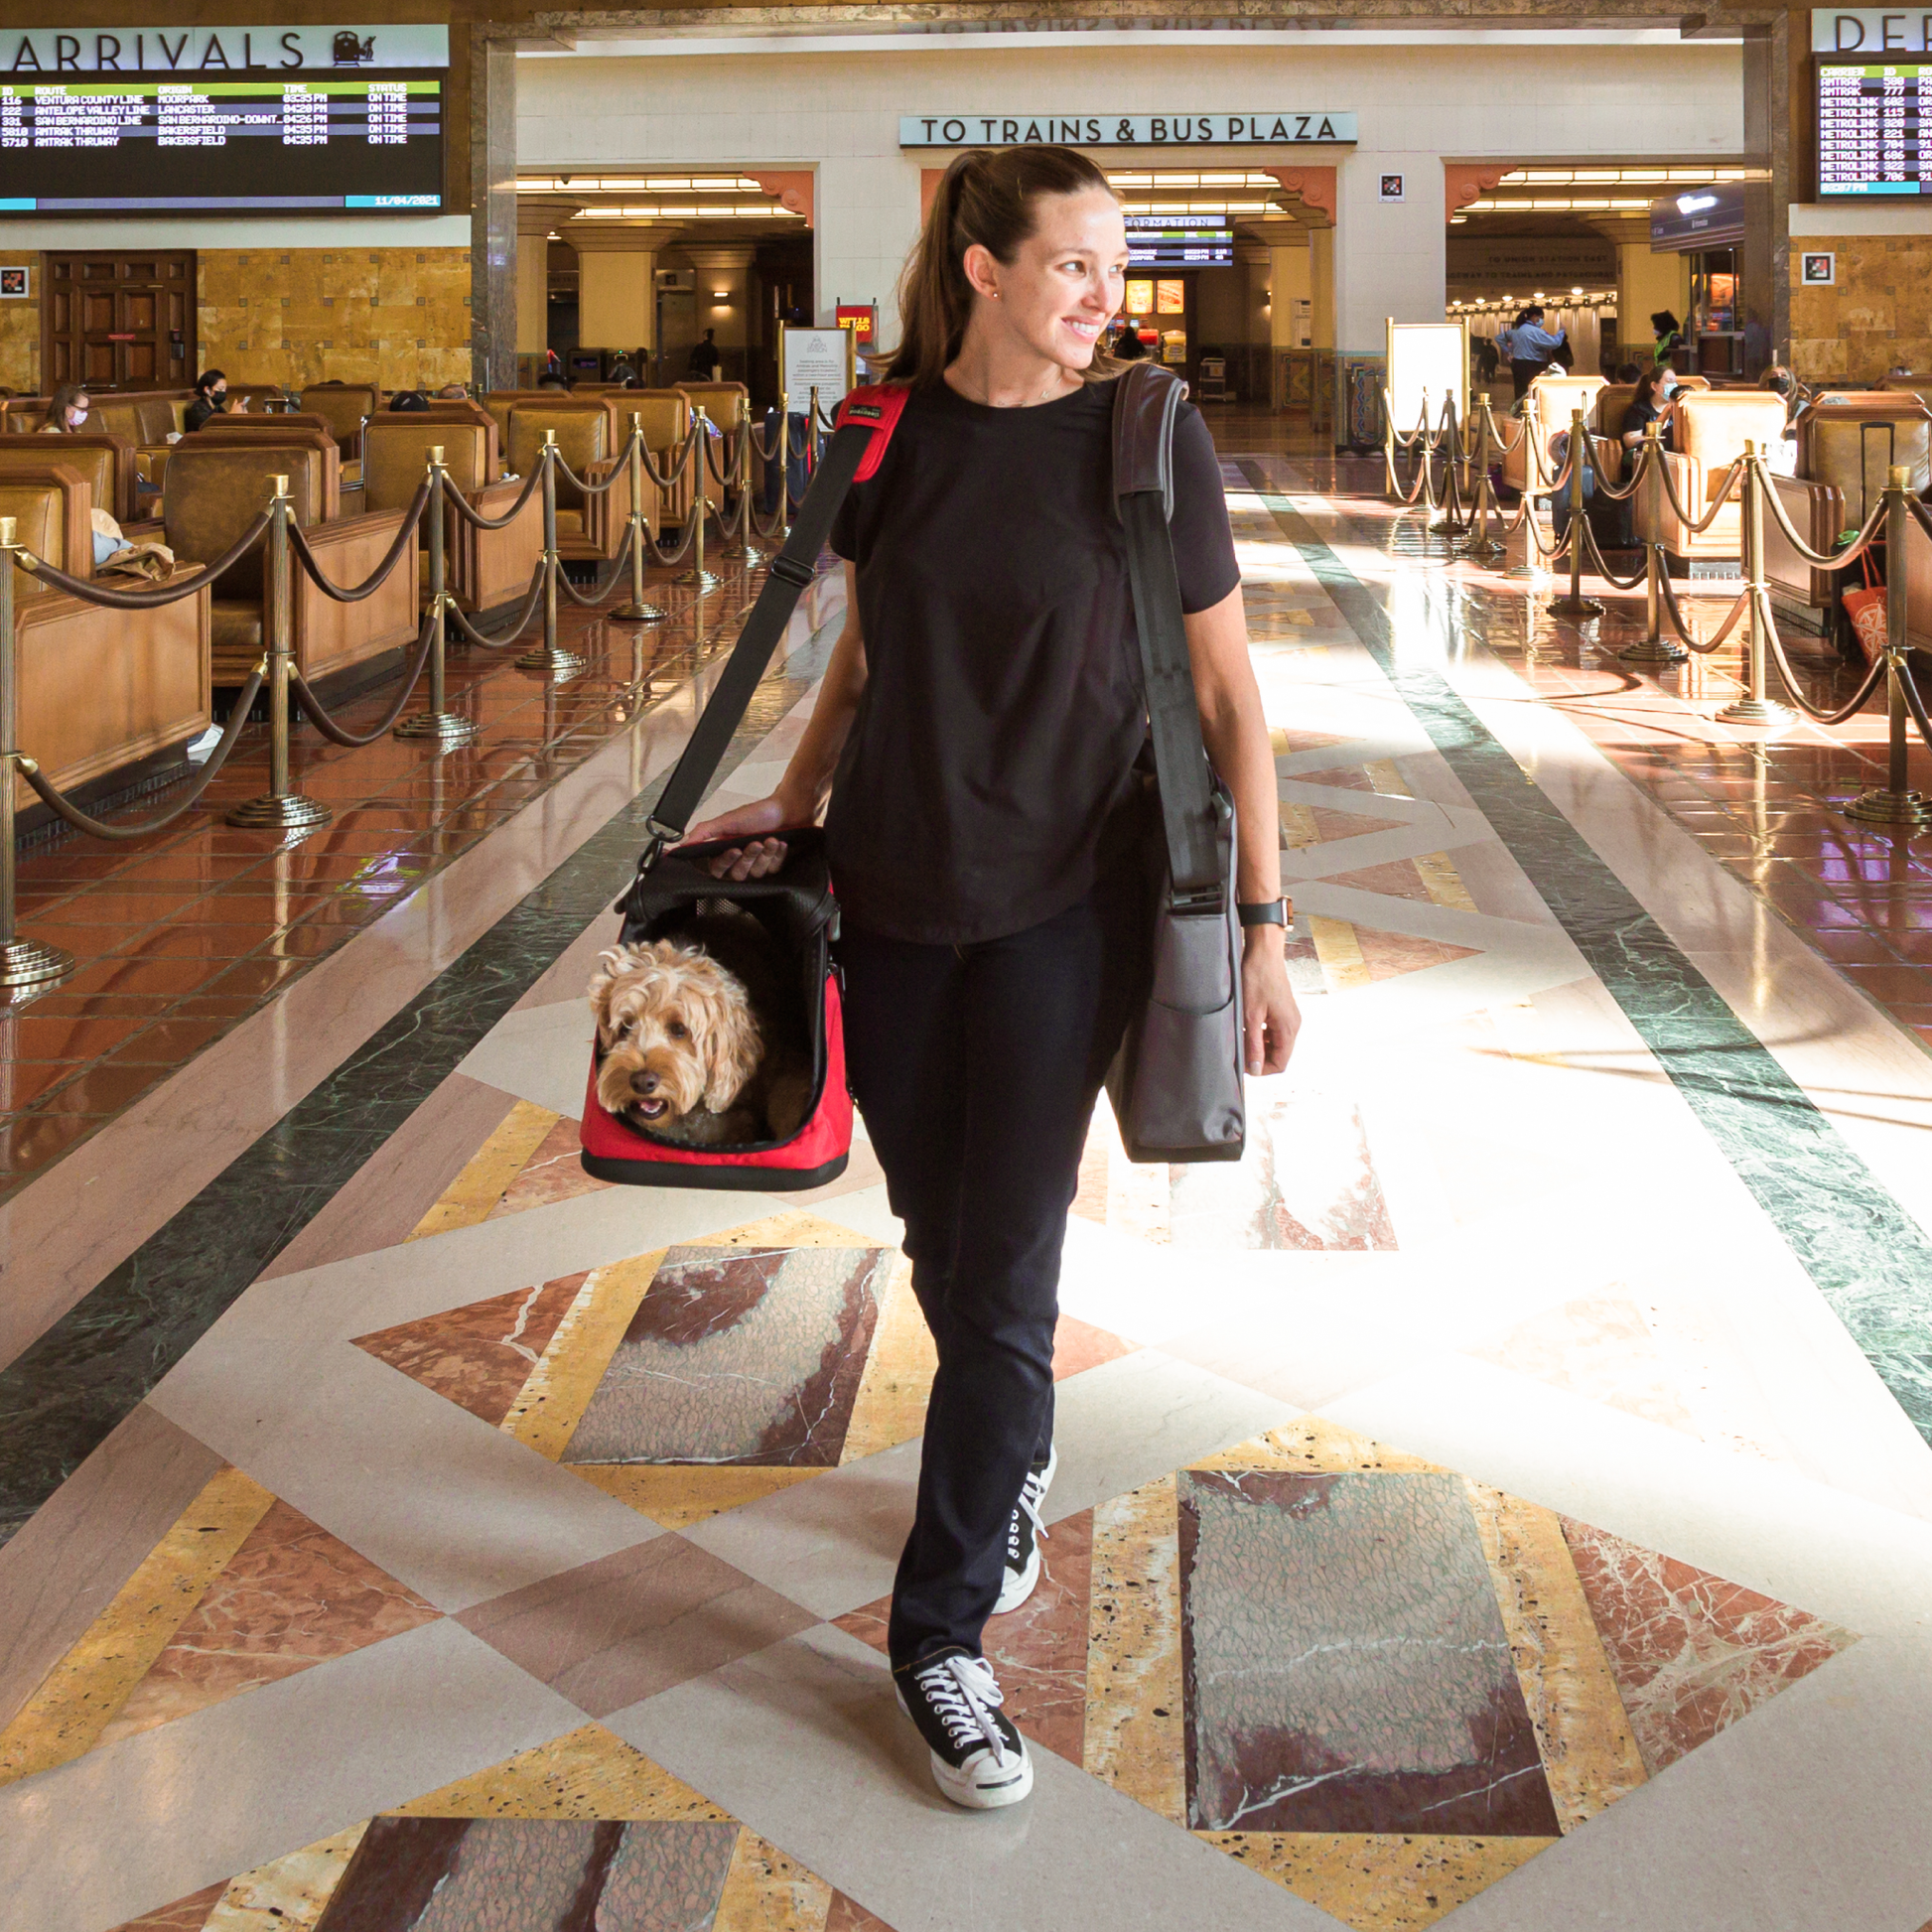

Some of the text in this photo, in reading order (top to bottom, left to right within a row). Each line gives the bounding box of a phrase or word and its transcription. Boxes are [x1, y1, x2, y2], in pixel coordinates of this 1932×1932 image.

[13, 33, 304, 70] ARRIVALS
[1820, 67, 1865, 76] CARRIER
[1883, 67, 1896, 76] ID
[1820, 77, 1862, 86] AMTRAK
[2, 83, 407, 96] ID ROUTE ORIGIN TIME STATUS
[1820, 87, 1862, 96] AMTRAK
[1882, 86, 1905, 96] 777
[2, 96, 22, 105] 116
[35, 95, 79, 104] VENTURA
[80, 95, 118, 104] COUNTY
[119, 95, 144, 104] LINE
[314, 93, 328, 102] PM
[368, 93, 382, 102] ON
[383, 93, 407, 102] TIME
[1820, 97, 1878, 106] METROLINK
[2, 106, 22, 115] 222
[35, 105, 85, 115] ANTELOPE
[86, 105, 125, 115] VALLEY
[126, 105, 150, 115] LINE
[314, 104, 328, 113] PM
[368, 103, 382, 112] ON
[383, 103, 407, 112] TIME
[1820, 108, 1878, 117] METROLINK
[1882, 107, 1905, 117] 115
[2, 117, 22, 126] 331
[35, 116, 55, 125] SAN
[56, 116, 117, 125] BERNARDINO
[118, 116, 142, 125] LINE
[158, 115, 179, 124] SAN
[368, 114, 382, 123] ON
[383, 114, 407, 123] TIME
[1820, 119, 1878, 128] METROLINK
[35, 127, 73, 136] AMTRAK
[74, 127, 119, 136] THRUWAY
[158, 126, 225, 135] BAKERSFIELD
[283, 125, 313, 134] 04:35
[314, 125, 328, 134] PM
[368, 124, 382, 133] ON
[383, 124, 407, 133] TIME
[921, 116, 1336, 143] TO TRAINS & BUS PLAZA
[1820, 129, 1878, 139] METROLINK
[1882, 129, 1905, 139] 221
[2, 135, 407, 147] 5710 AMTRAK THRUWAY BAKERSFIELD 04:35 PM ON TIME
[1820, 140, 1878, 149] METROLINK
[1820, 151, 1878, 160] METROLINK
[1820, 161, 1878, 171] METROLINK
[1882, 161, 1905, 171] 322
[1820, 172, 1878, 181] METROLINK
[374, 196, 438, 206] 11/04/2021
